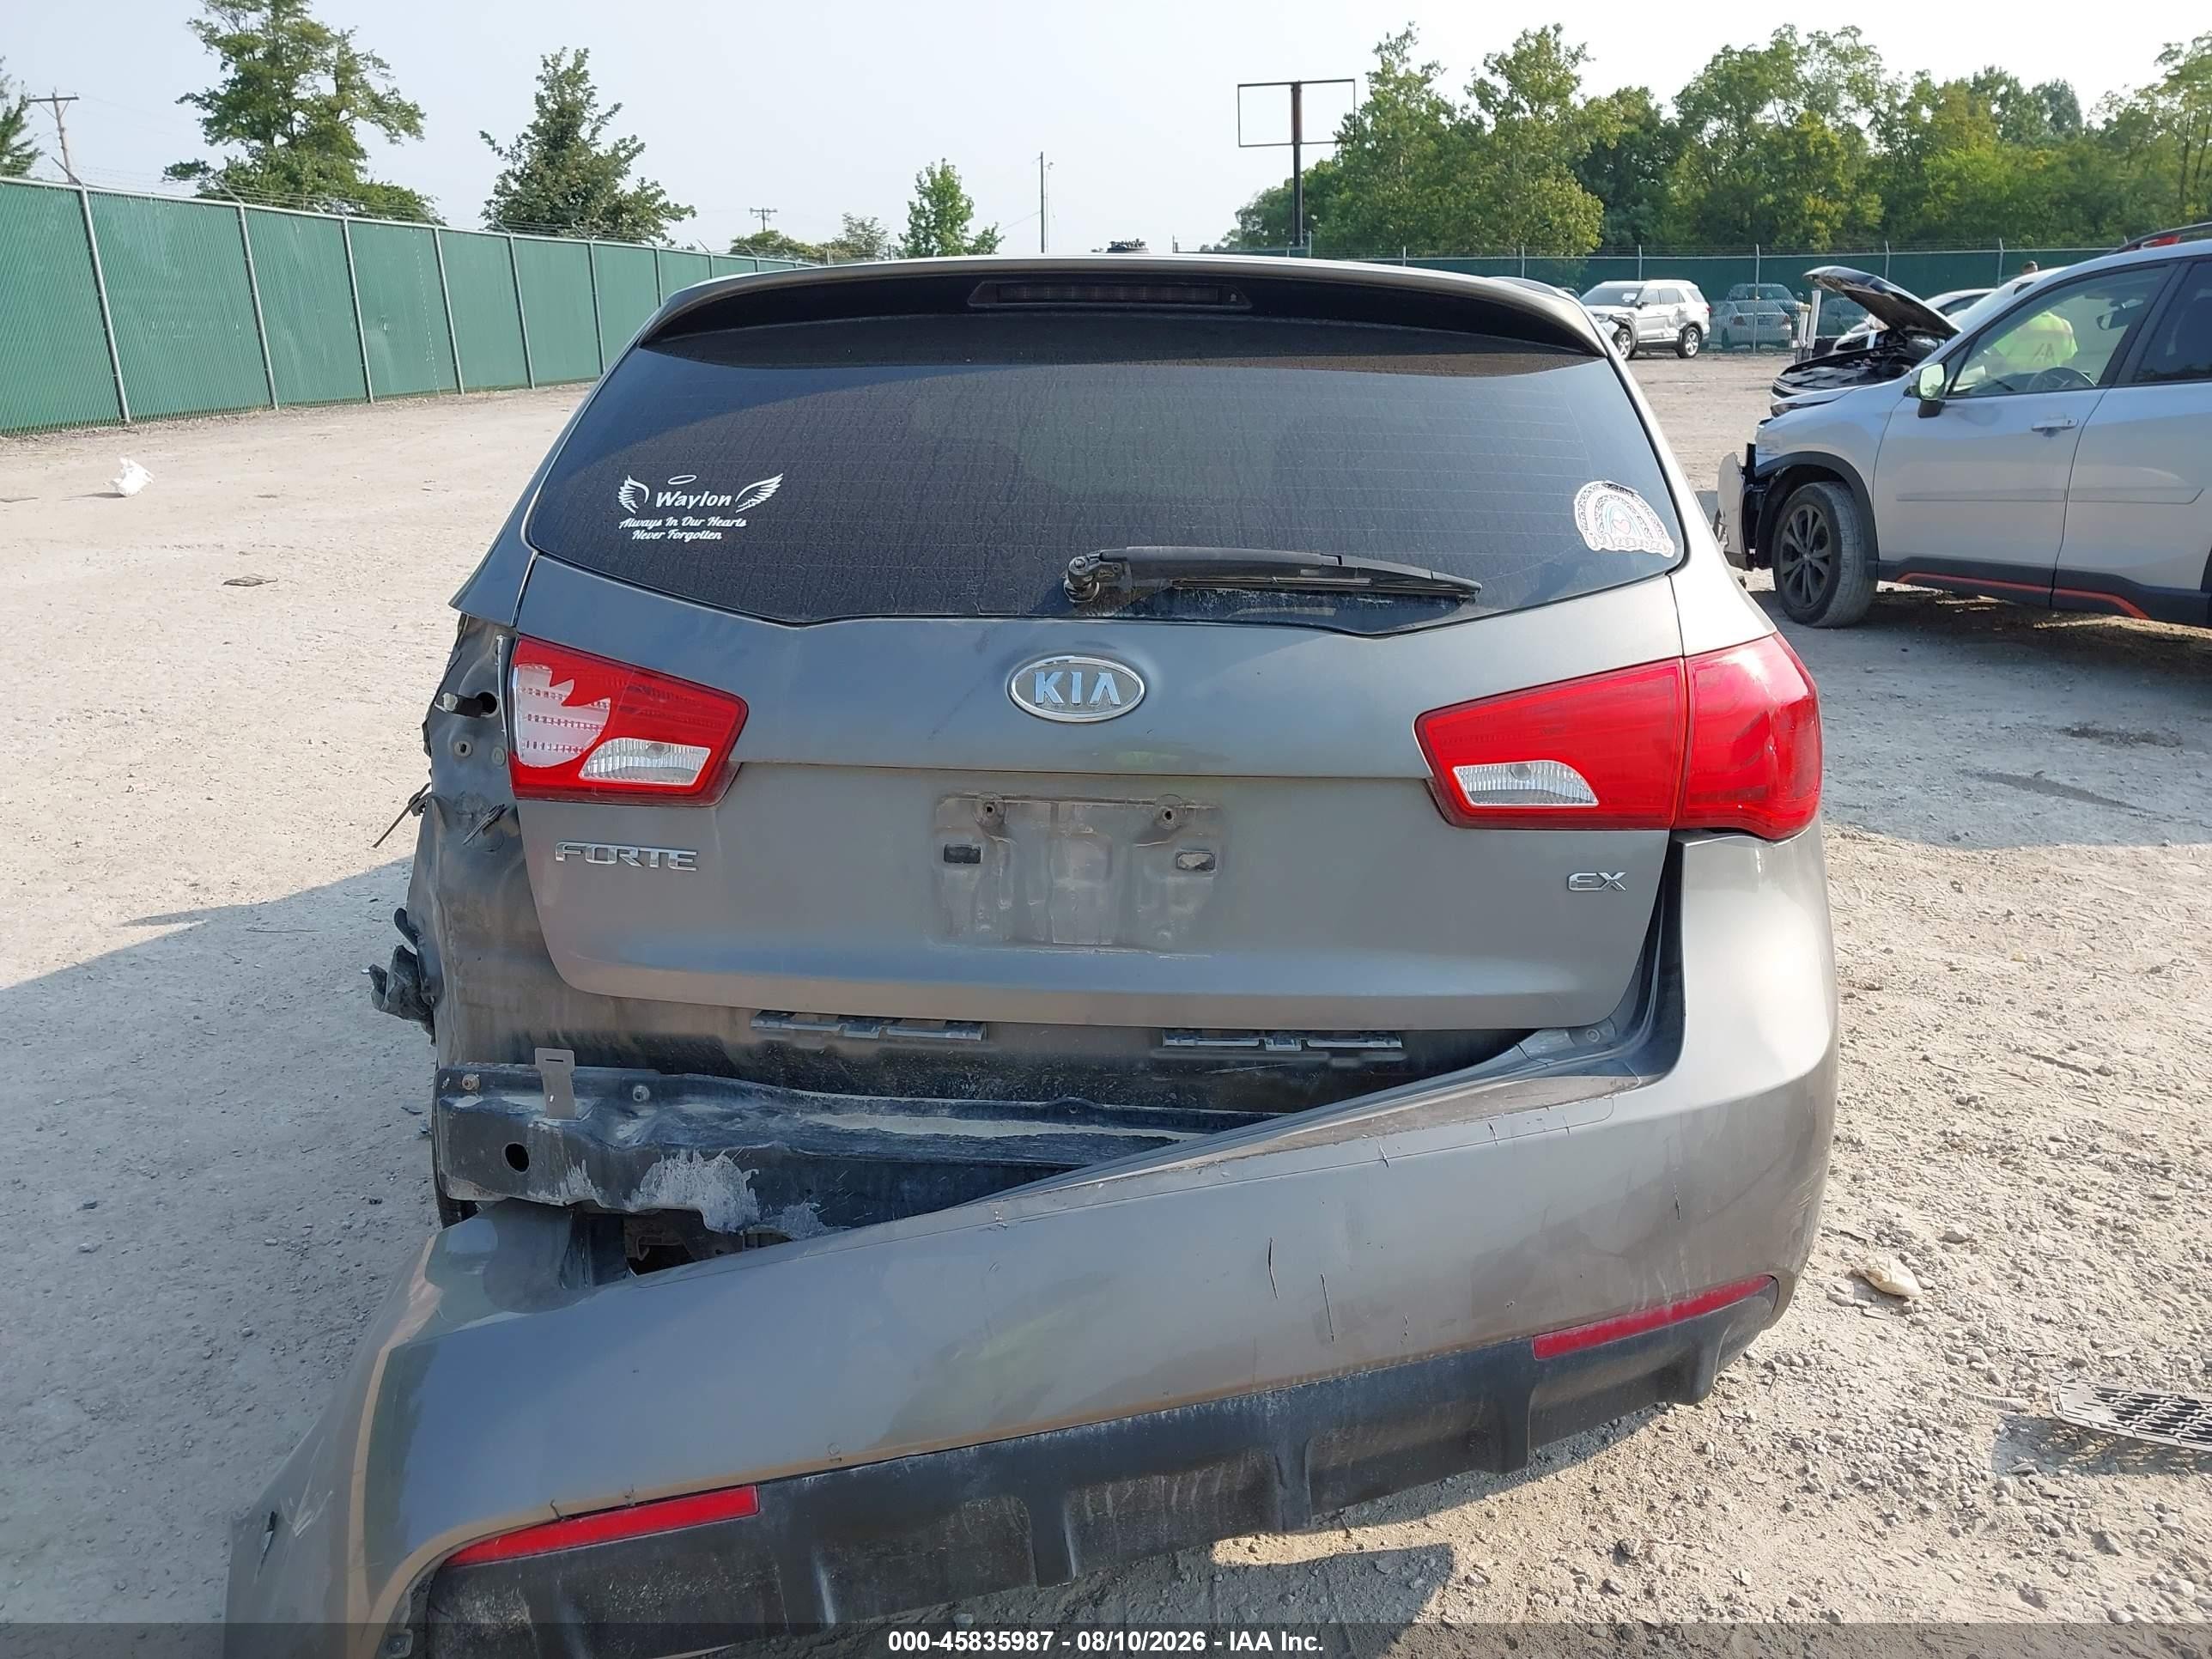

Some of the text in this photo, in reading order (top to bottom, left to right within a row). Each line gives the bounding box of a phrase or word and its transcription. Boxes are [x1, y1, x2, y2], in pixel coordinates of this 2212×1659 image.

[655, 490, 732, 509] Waylon
[618, 516, 747, 530] Always In Our Hearts
[631, 528, 723, 543] Never Forgotten
[1034, 672, 1121, 706] KIA
[555, 841, 698, 872] FORTE
[1567, 872, 1627, 891] EX
